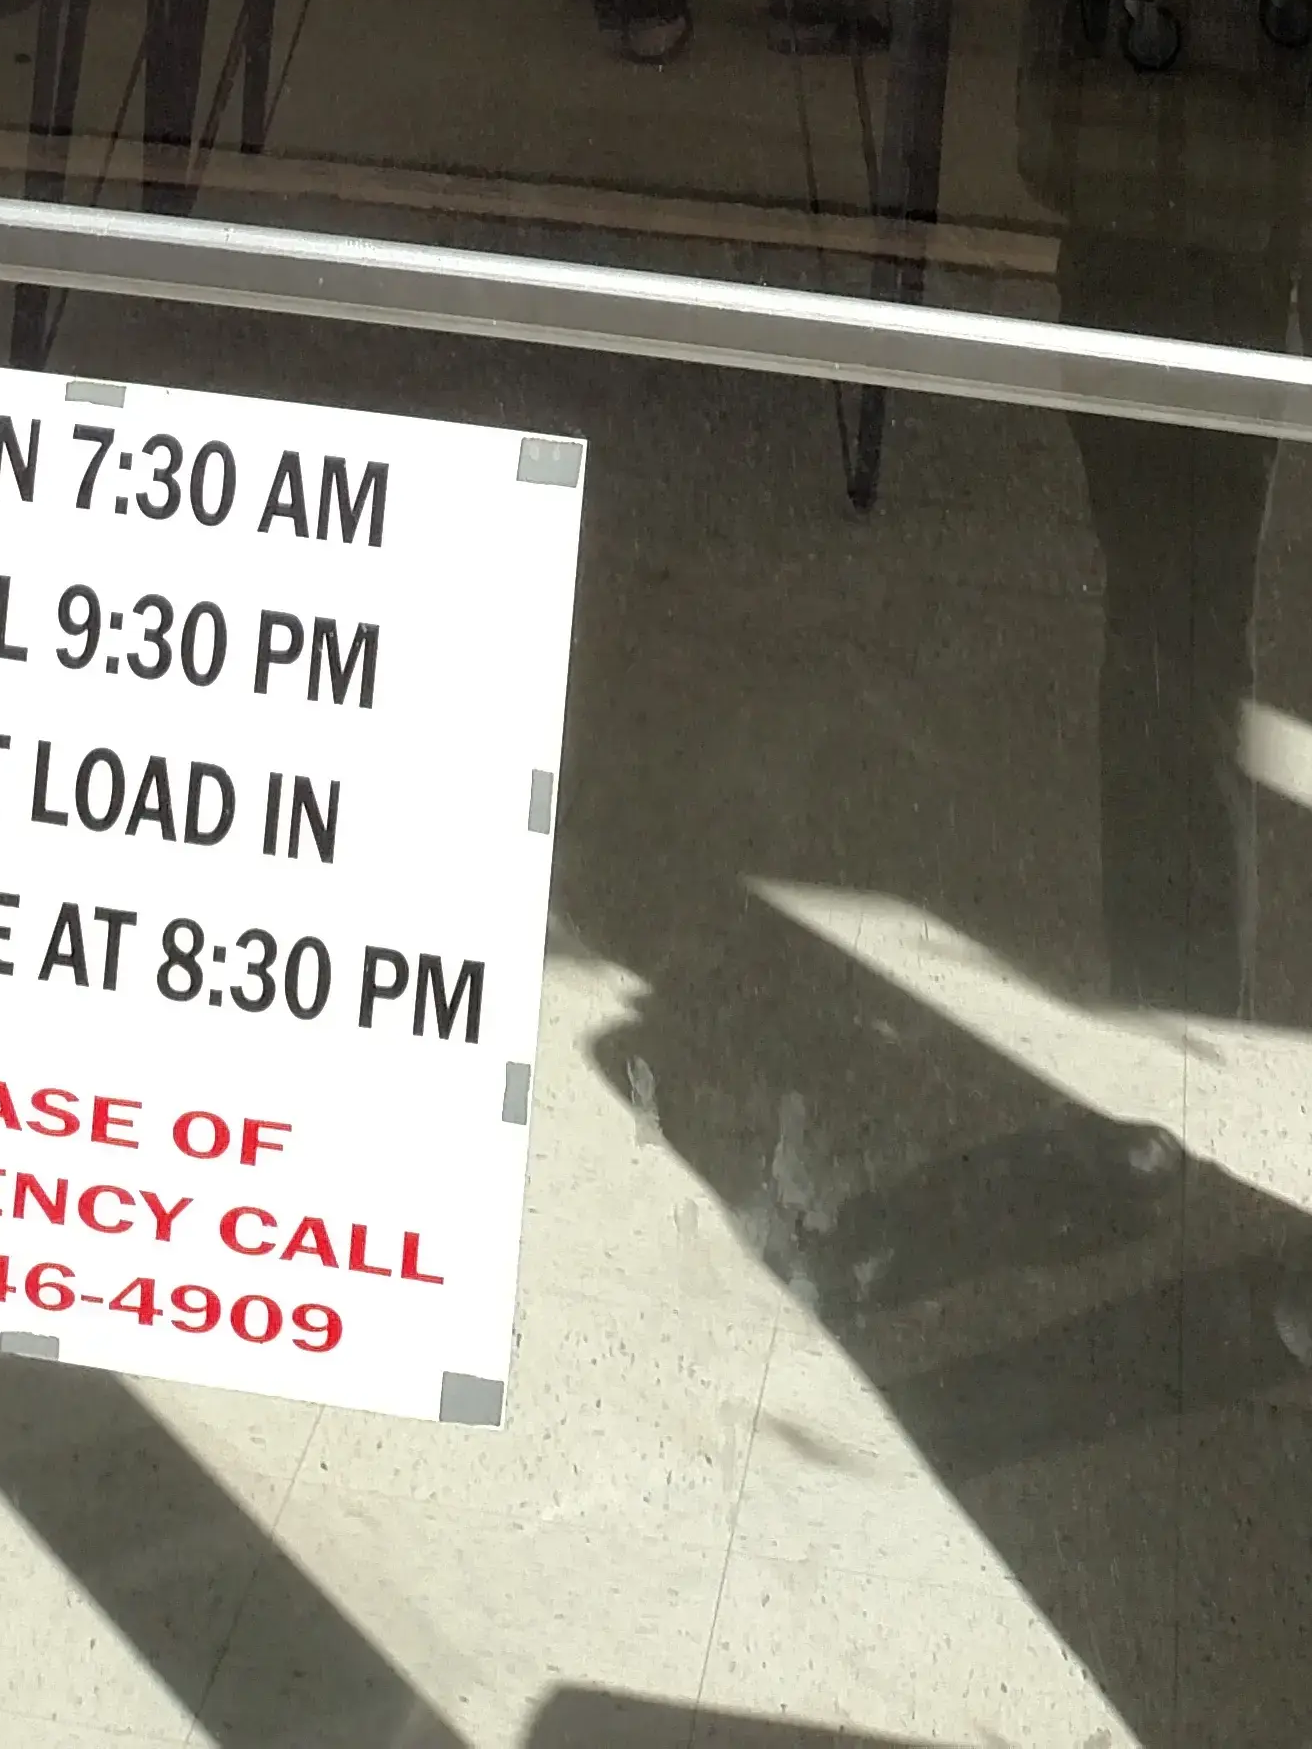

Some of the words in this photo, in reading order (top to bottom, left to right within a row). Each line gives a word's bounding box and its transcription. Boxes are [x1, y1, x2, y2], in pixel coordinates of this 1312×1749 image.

[71, 422, 237, 528] 7:30
[256, 449, 390, 549] AM
[55, 584, 228, 688] 9:30
[252, 608, 381, 710] PM
[30, 739, 237, 847] LOAD
[261, 771, 342, 865] IN
[36, 901, 139, 992] AT
[155, 917, 332, 1021] 8:30
[357, 944, 486, 1045] PM
[172, 1110, 292, 1167] OF
[218, 1205, 446, 1285] CALL
